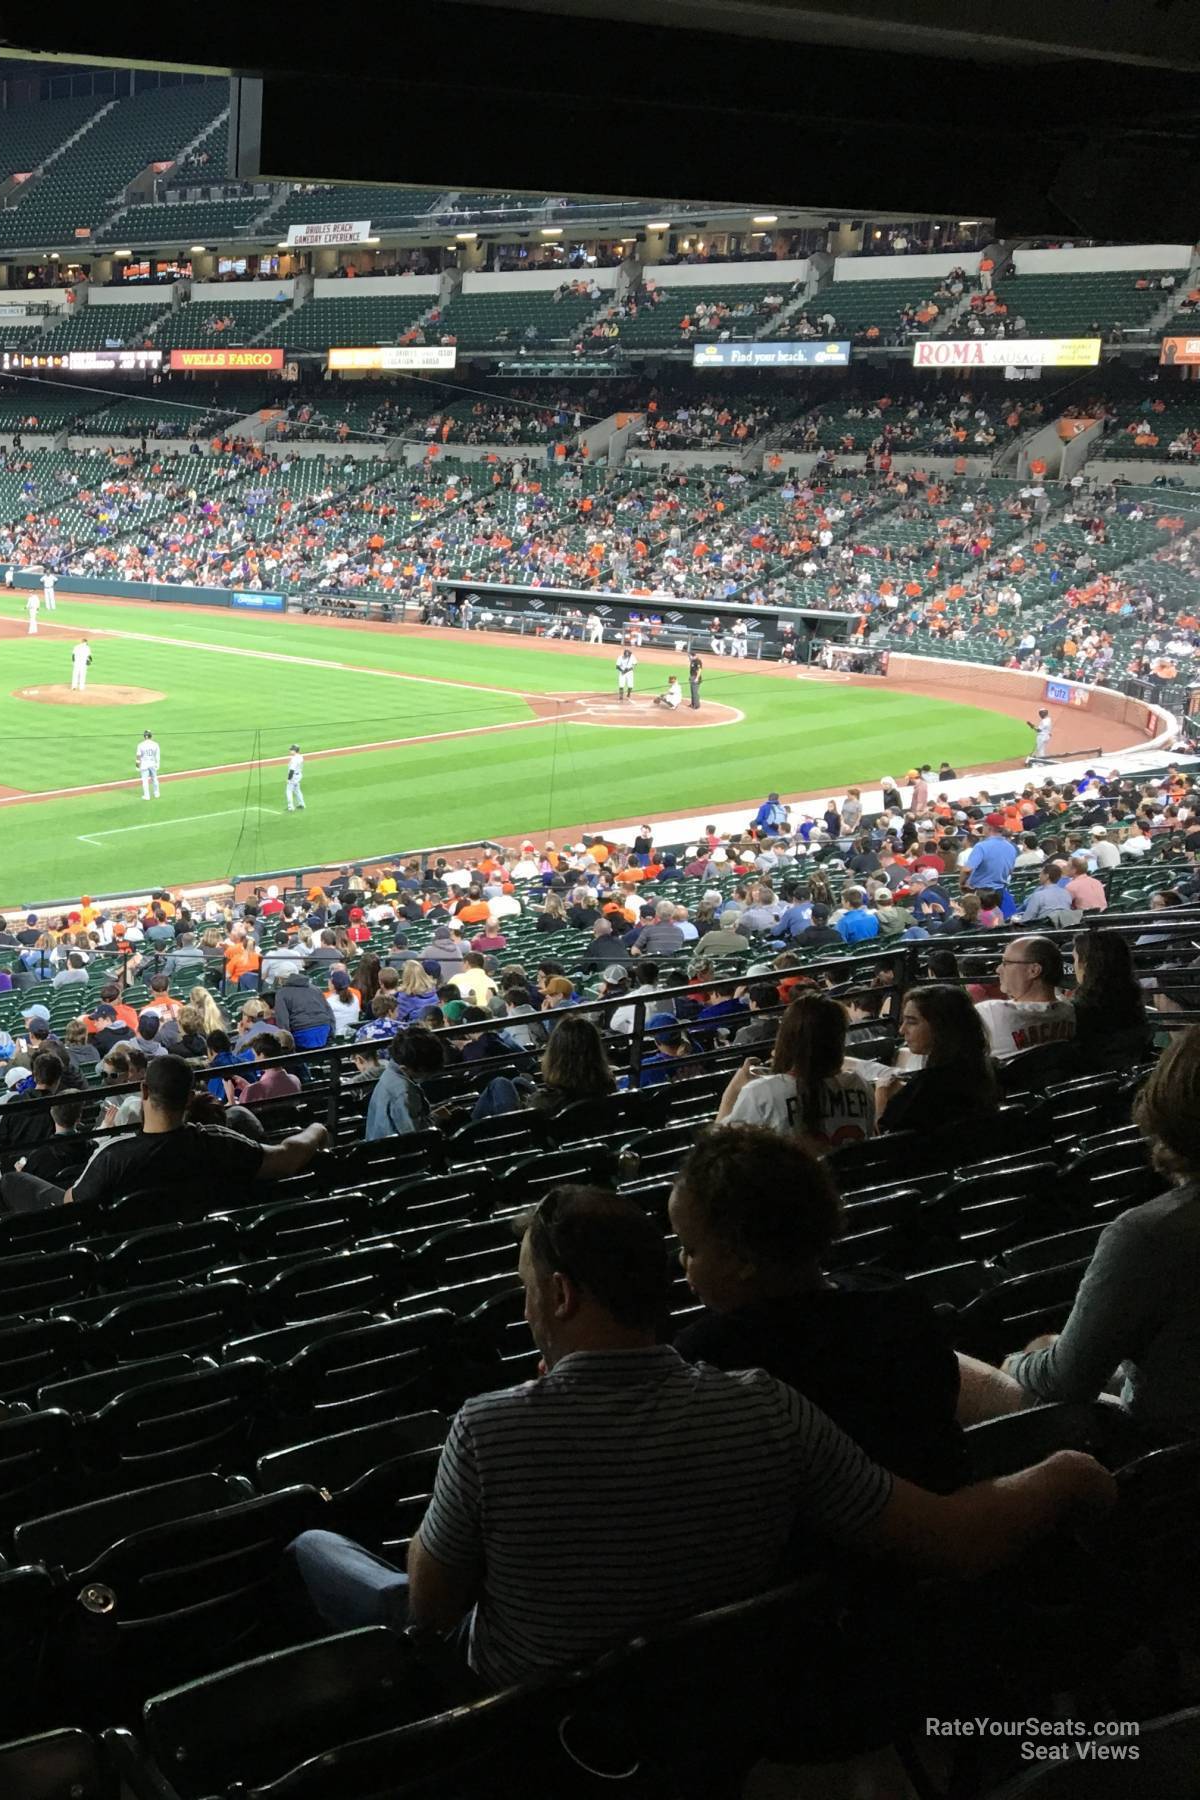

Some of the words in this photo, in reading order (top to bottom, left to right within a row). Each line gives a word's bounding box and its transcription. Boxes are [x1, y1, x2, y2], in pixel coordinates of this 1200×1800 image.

[324, 232, 361, 243] EXPERIENCE
[182, 353, 225, 366] WELLS
[228, 353, 273, 365] FARGO
[731, 350, 752, 362] Find
[755, 353, 776, 365] your
[778, 350, 808, 362] beach.
[917, 342, 985, 364] ROMA
[991, 352, 1047, 364] SAUSAGE
[786, 1088, 868, 1127] PLMER
